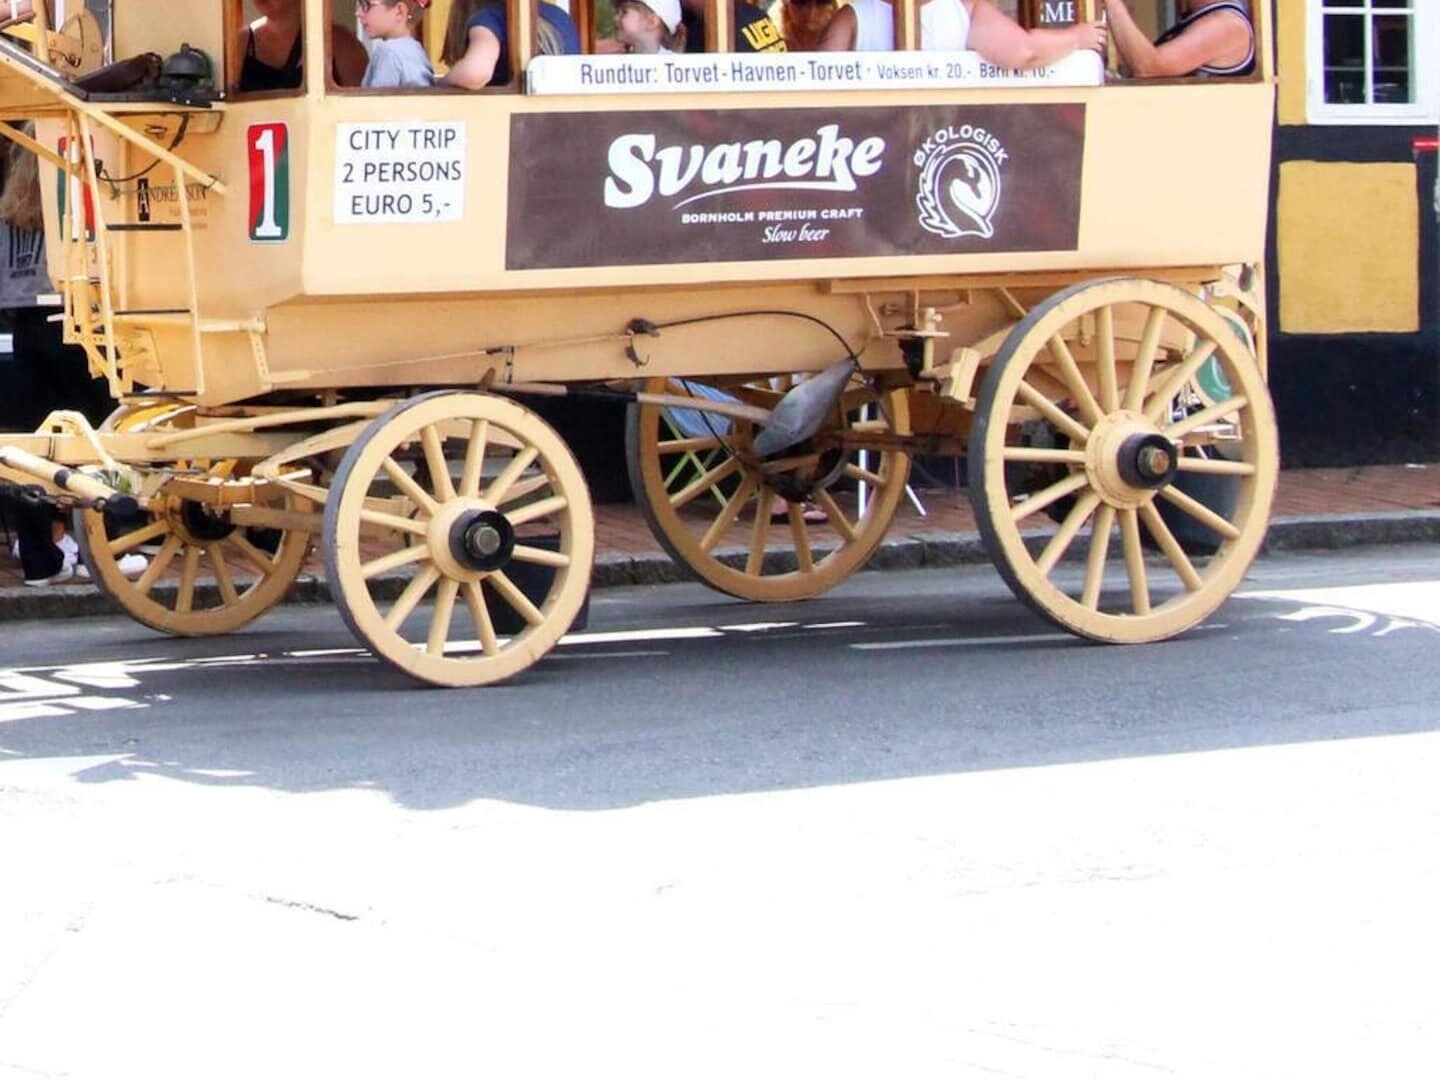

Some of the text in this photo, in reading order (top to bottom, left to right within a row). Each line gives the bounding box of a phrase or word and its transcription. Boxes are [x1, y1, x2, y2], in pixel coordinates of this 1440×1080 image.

[580, 63, 658, 85] Rundtur:
[664, 61, 718, 83] Torvet
[731, 60, 797, 82] Havnen
[807, 59, 862, 81] Torvet
[876, 63, 924, 80] Voksen
[349, 127, 457, 151] CITY TRIP
[913, 123, 1009, 168] ØKOLOGISK
[342, 159, 462, 184] 2 PERSONS
[604, 124, 887, 209] Svaneke
[254, 128, 282, 237] 1
[351, 193, 451, 218] EURO 5,-
[681, 207, 864, 225] BORNHOLM PREMIUM CRAFT
[762, 221, 830, 244] Slow beer
